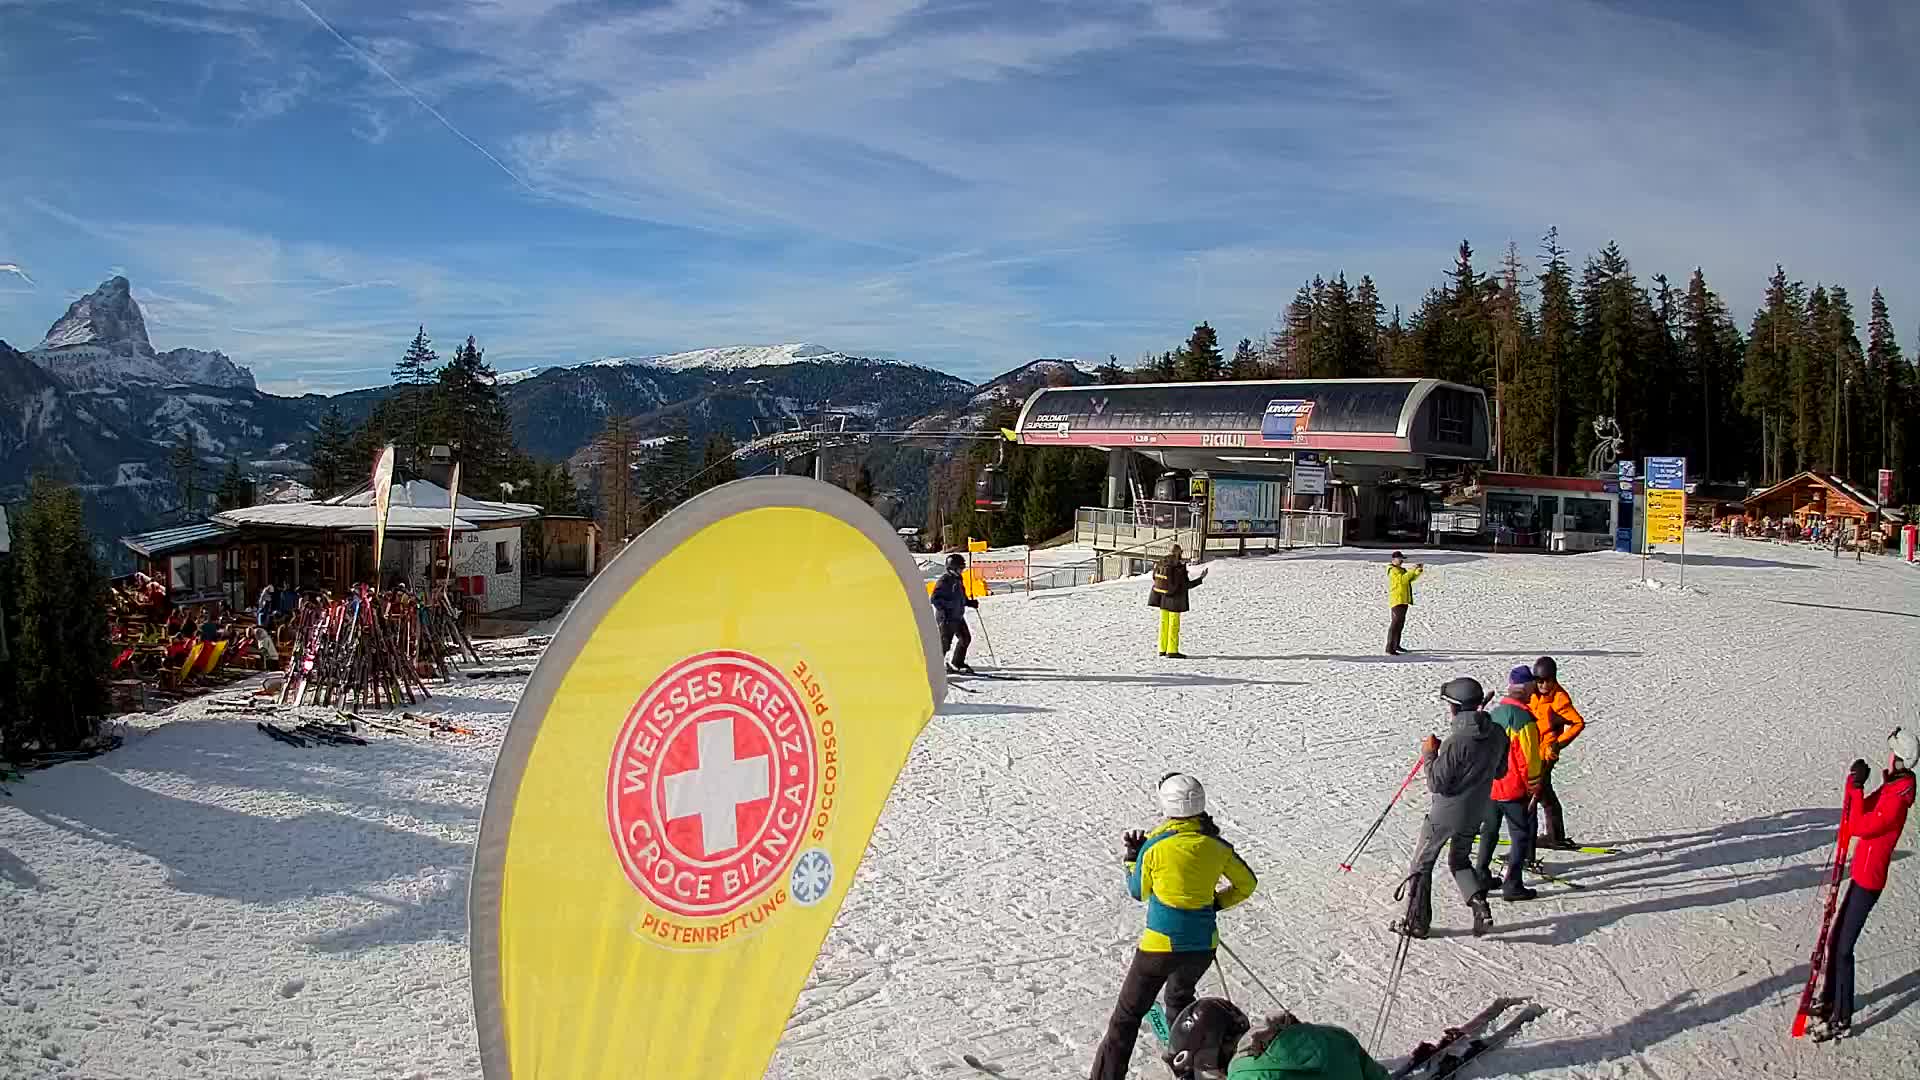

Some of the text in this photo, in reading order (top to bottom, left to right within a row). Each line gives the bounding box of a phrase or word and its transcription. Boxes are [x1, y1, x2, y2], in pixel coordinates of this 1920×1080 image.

[1036, 414, 1069, 422] DOLOMITI
[623, 671, 803, 795] WEISSES KREUZ
[792, 660, 838, 842] SOCCORSO PISTE
[629, 783, 806, 899] CROCE BIANCA
[641, 888, 787, 944] PISTENRETTUNG
